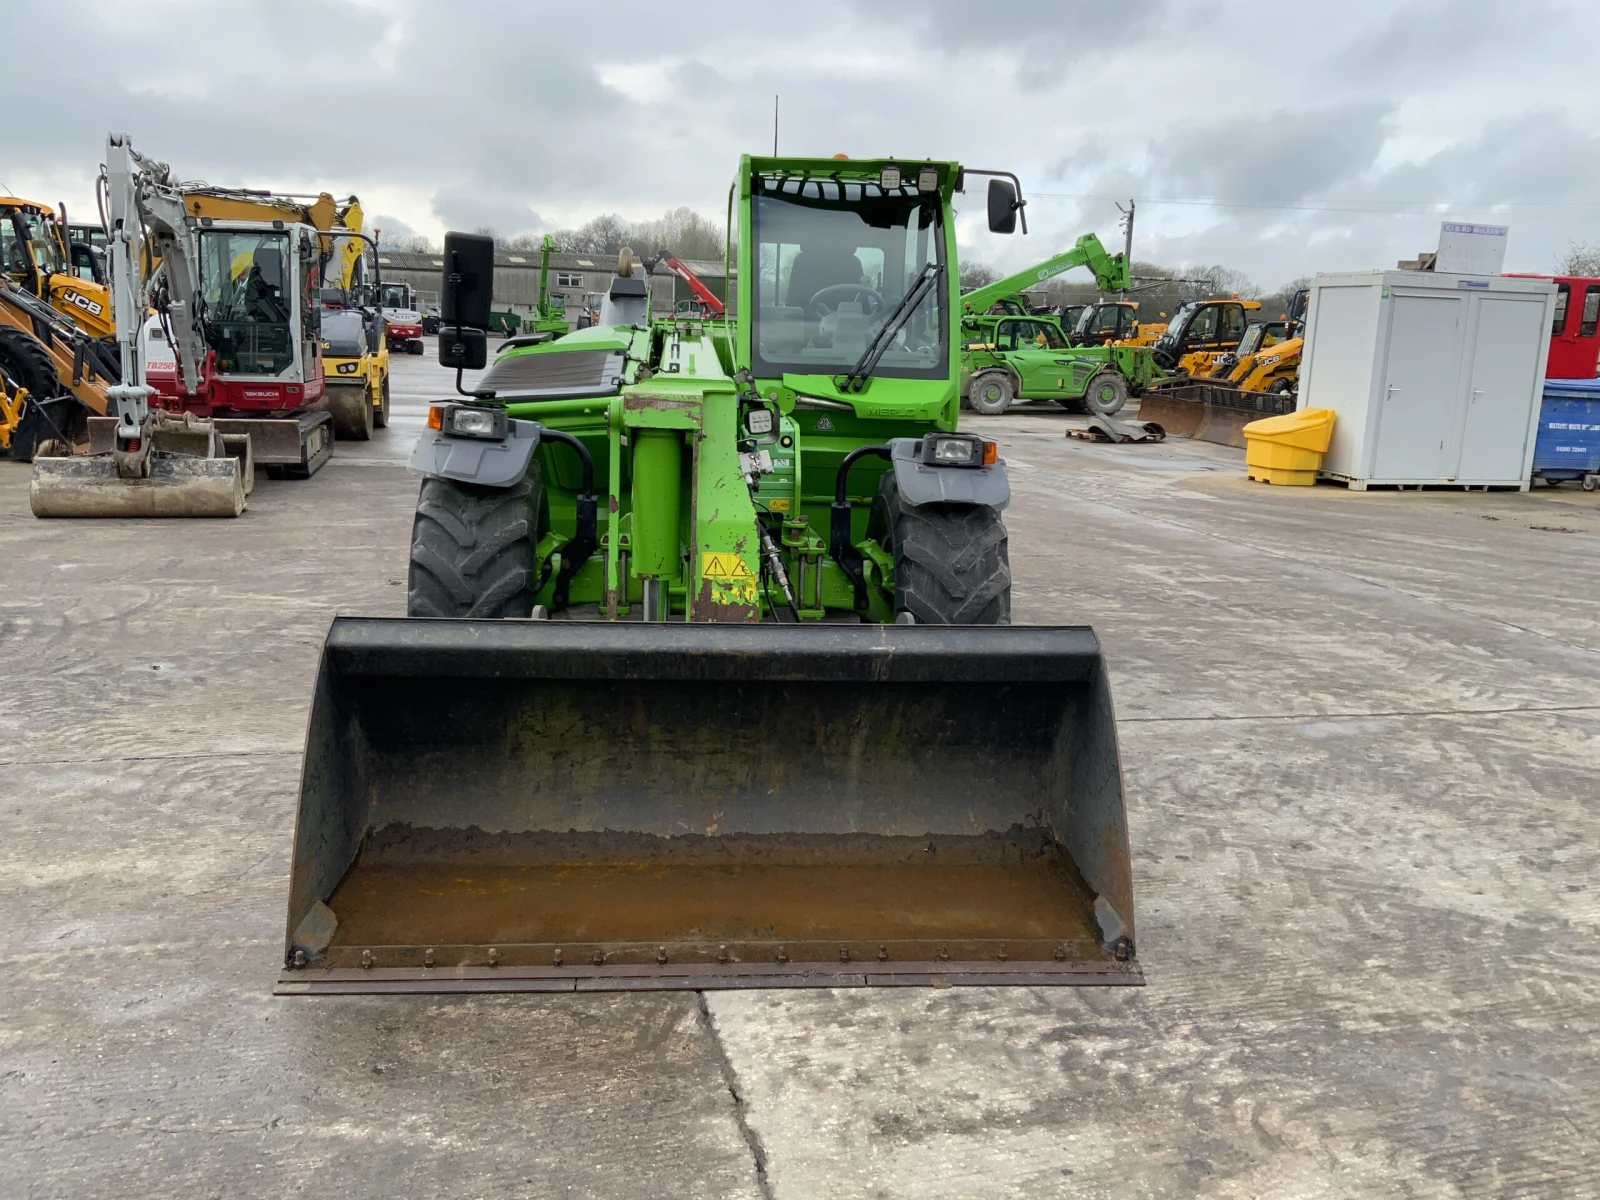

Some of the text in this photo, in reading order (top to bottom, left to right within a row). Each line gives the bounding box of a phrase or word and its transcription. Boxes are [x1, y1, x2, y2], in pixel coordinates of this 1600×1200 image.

[64, 292, 102, 315] JCB
[1262, 356, 1280, 367] JCB
[868, 406, 916, 417] MERLO
